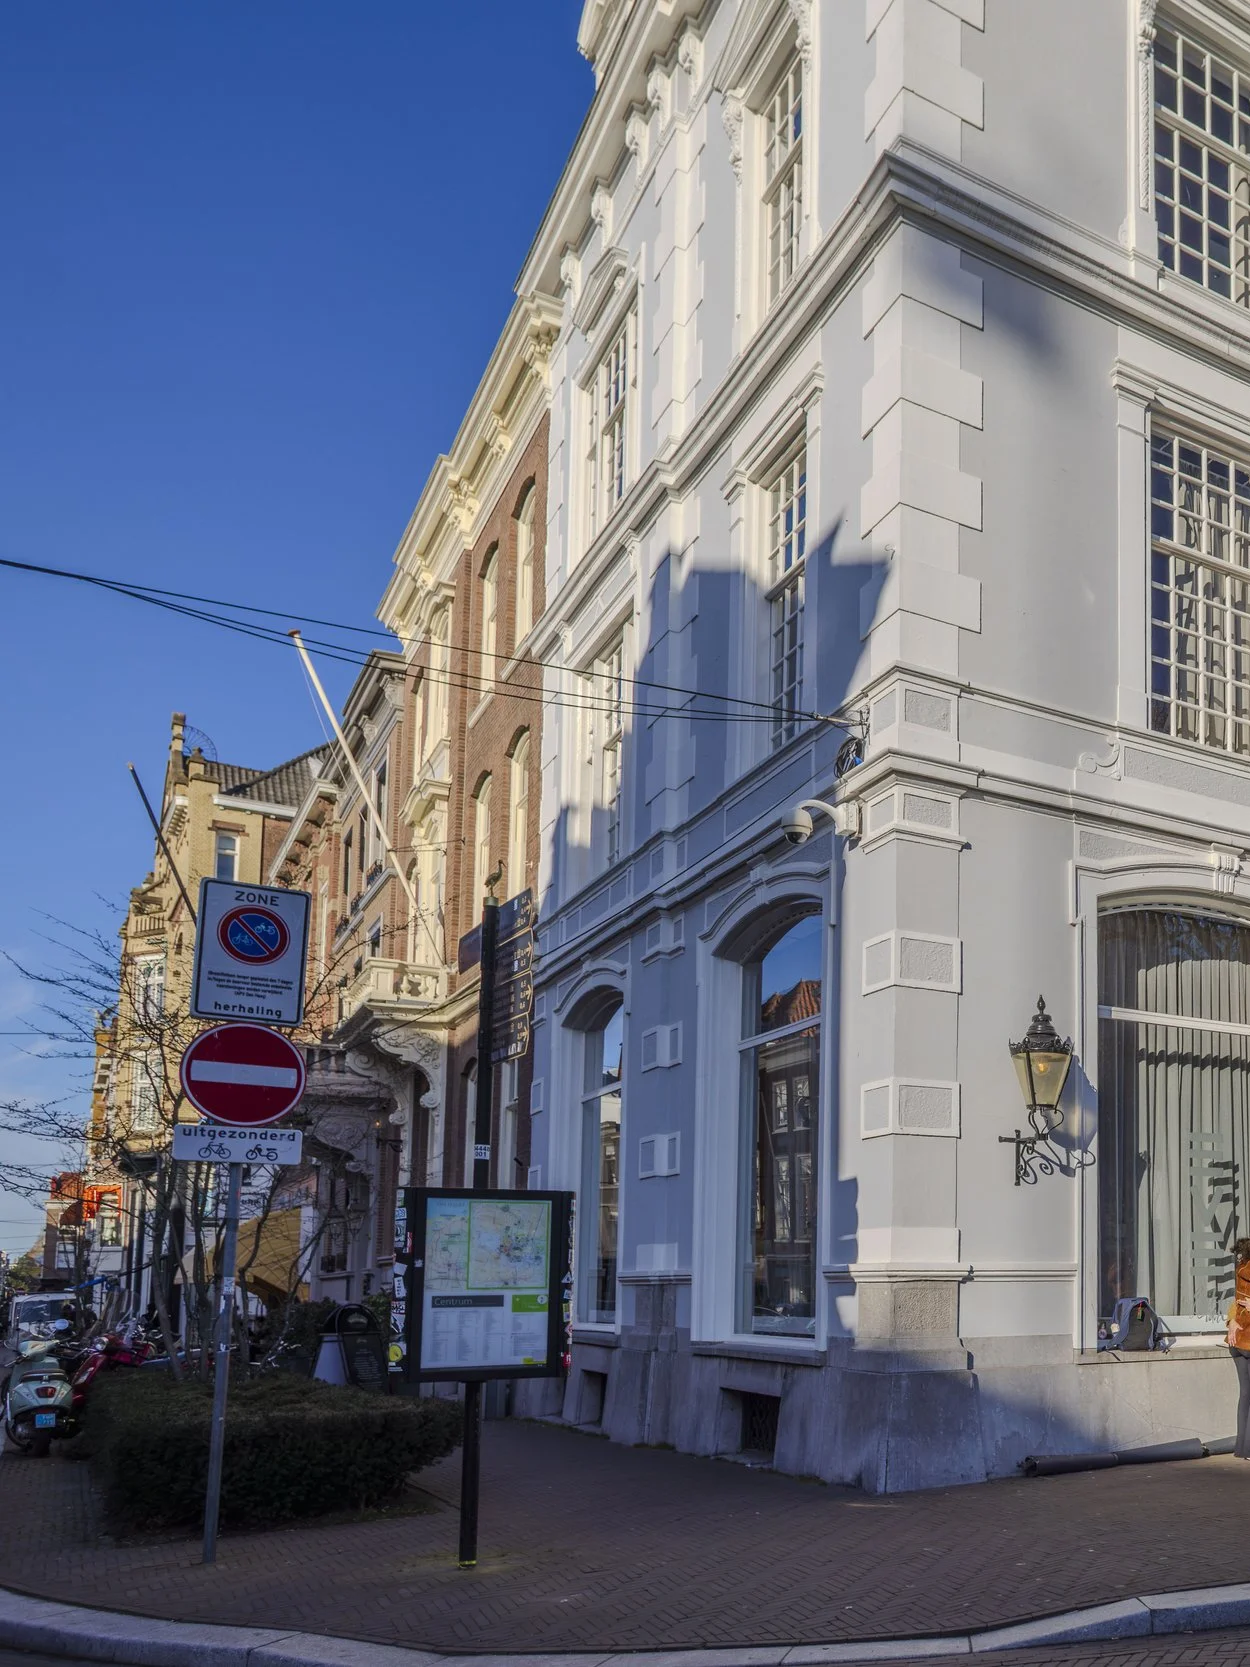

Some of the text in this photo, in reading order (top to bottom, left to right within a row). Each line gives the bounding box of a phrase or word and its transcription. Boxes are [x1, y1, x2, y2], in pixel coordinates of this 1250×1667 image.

[235, 890, 280, 907] ZONE
[214, 1001, 282, 1019] herhaling
[182, 1127, 296, 1141] uitgezonderd
[434, 1297, 473, 1306] Centrum
